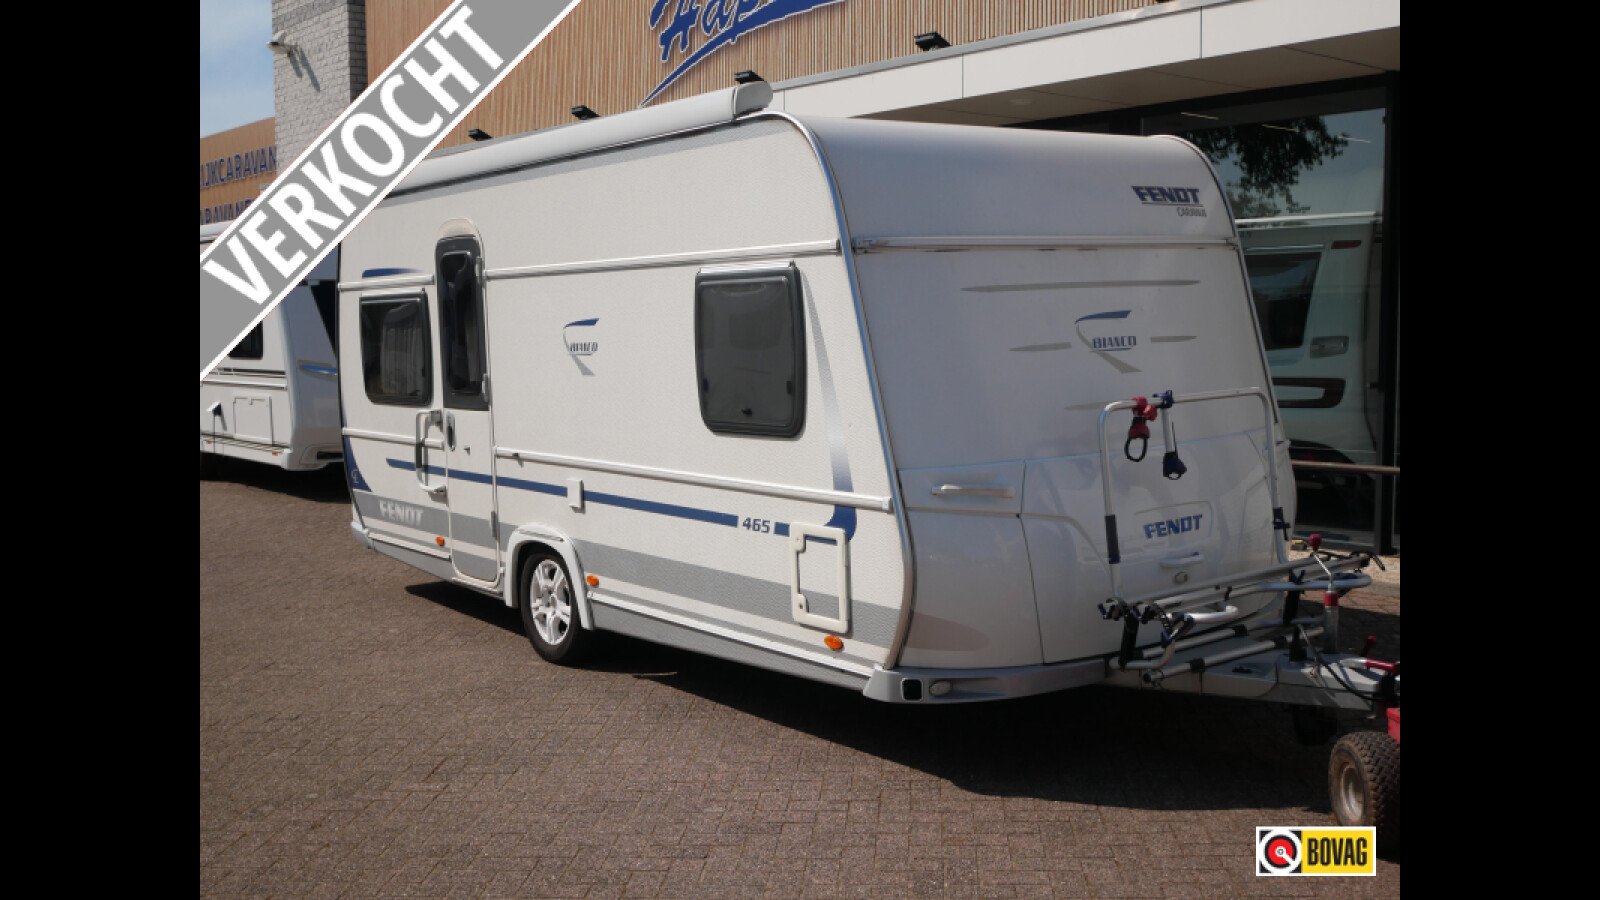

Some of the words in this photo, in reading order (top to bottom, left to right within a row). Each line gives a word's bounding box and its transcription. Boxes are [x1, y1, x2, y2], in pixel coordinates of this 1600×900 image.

[1131, 186, 1200, 204] FENDT
[1092, 335, 1137, 349] BIANCO
[379, 500, 424, 525] FENDT
[742, 517, 771, 533] 465
[1143, 514, 1203, 539] FENDT
